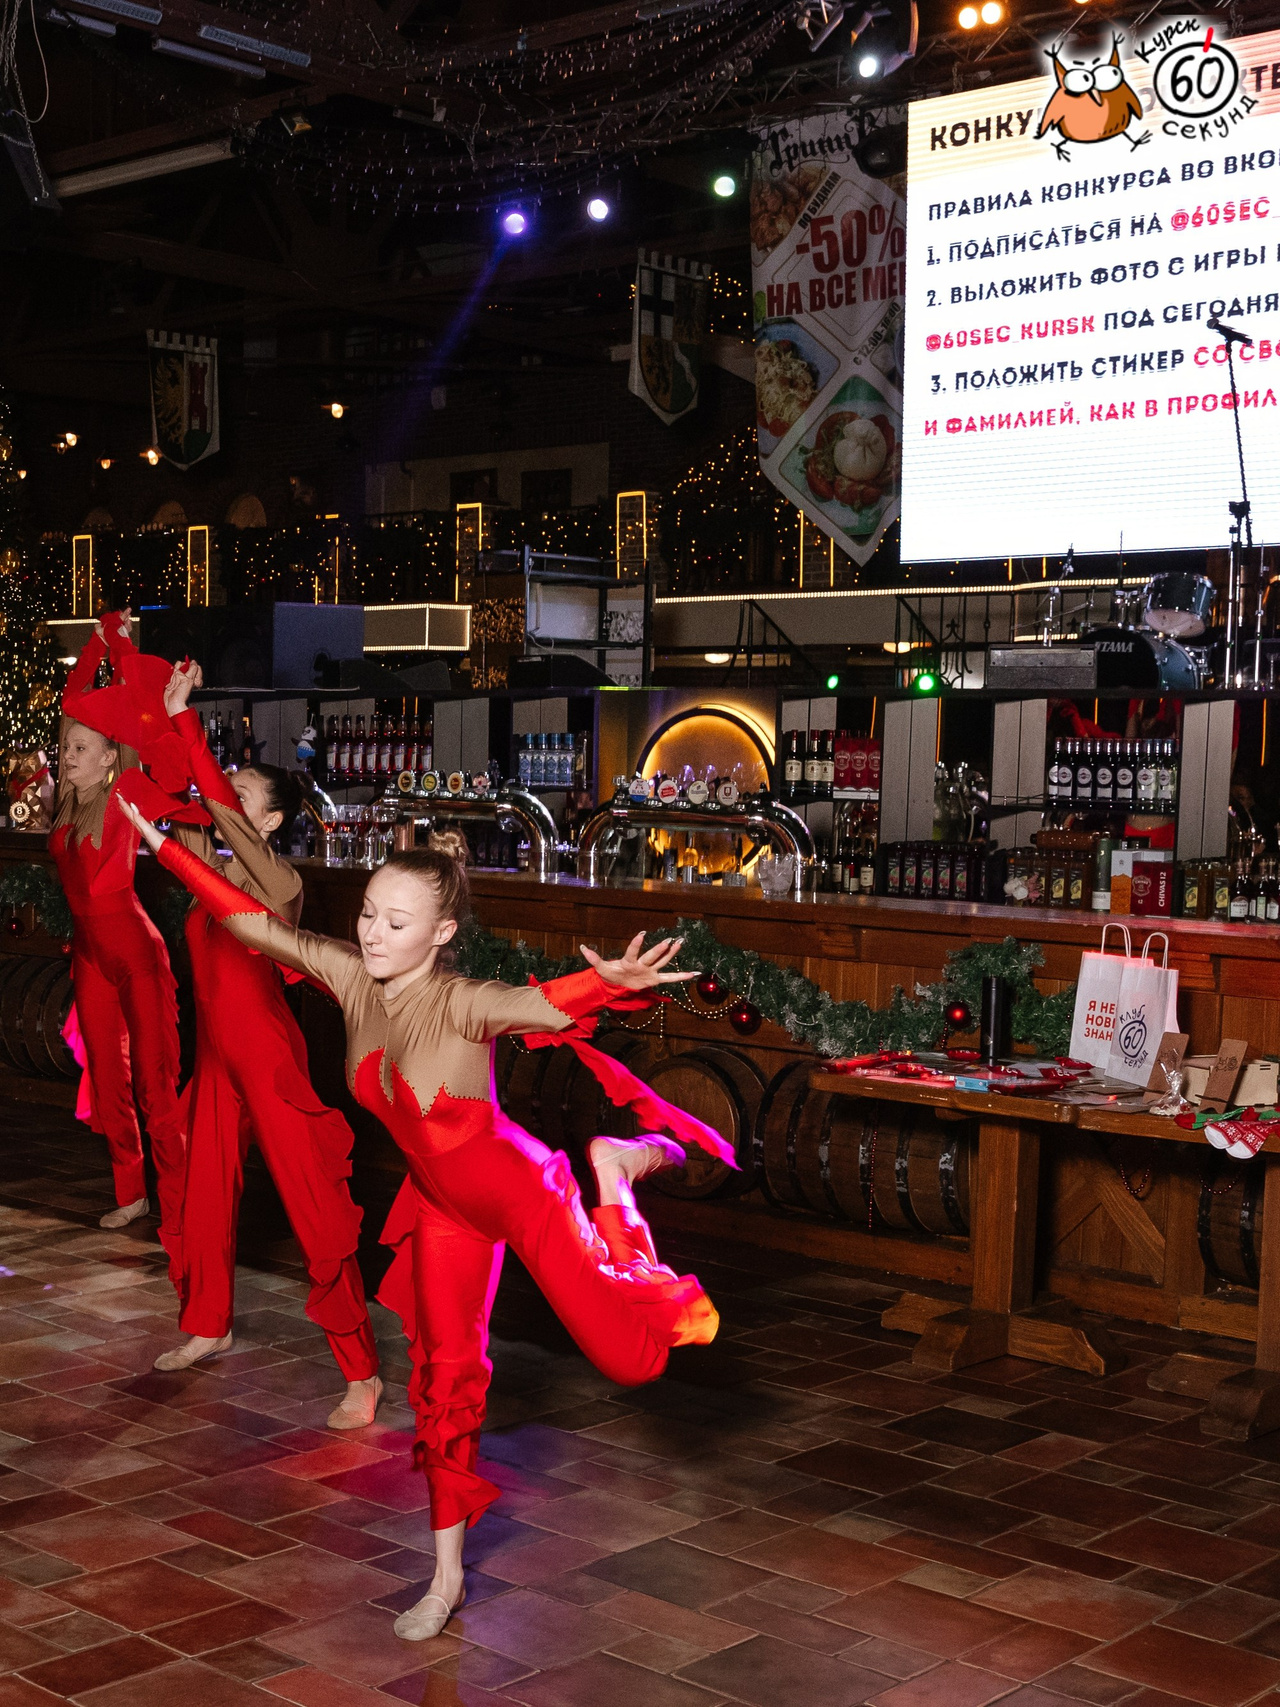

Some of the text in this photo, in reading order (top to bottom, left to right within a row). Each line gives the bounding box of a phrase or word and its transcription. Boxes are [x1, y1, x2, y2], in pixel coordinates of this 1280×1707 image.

[930, 107, 1042, 151] КОНКУ
[798, 171, 841, 230] ПО БУДНЯМ
[928, 149, 1280, 221] ПРАВИЛА КОНКУРСА ВО ВКО
[796, 200, 906, 274] -50%
[927, 246, 941, 266] 1.
[949, 218, 1121, 263] ПОДПИСАТЬСЯ
[1130, 212, 1163, 237] НА
[766, 282, 804, 318] НА
[809, 271, 857, 312] ВСЕ
[927, 289, 942, 307] 2.
[950, 271, 1082, 304] ВЫЛОЖИТЬ
[1090, 260, 1159, 285] ФОТО
[1168, 256, 1184, 275] С
[1194, 245, 1266, 273] ИГРЫ
[1104, 308, 1155, 331] ПОД
[1163, 293, 1279, 323] СЕГОДНЯ
[931, 340, 1280, 394] 3. ПОЛОЖИТЬ СТИКЕР СО СВ
[924, 419, 938, 436] И
[1090, 400, 1136, 422] КАК
[1145, 399, 1158, 418] В
[1168, 388, 1277, 416] ПРОФИЛ
[1097, 641, 1134, 653] TAMA
[16, 806, 23, 815] 8
[1158, 871, 1167, 908] CHIVAS 12
[1088, 1000, 1116, 1015] Я НЕ
[1084, 1027, 1113, 1042] ЗНАН
[1123, 1026, 1143, 1049] 60
